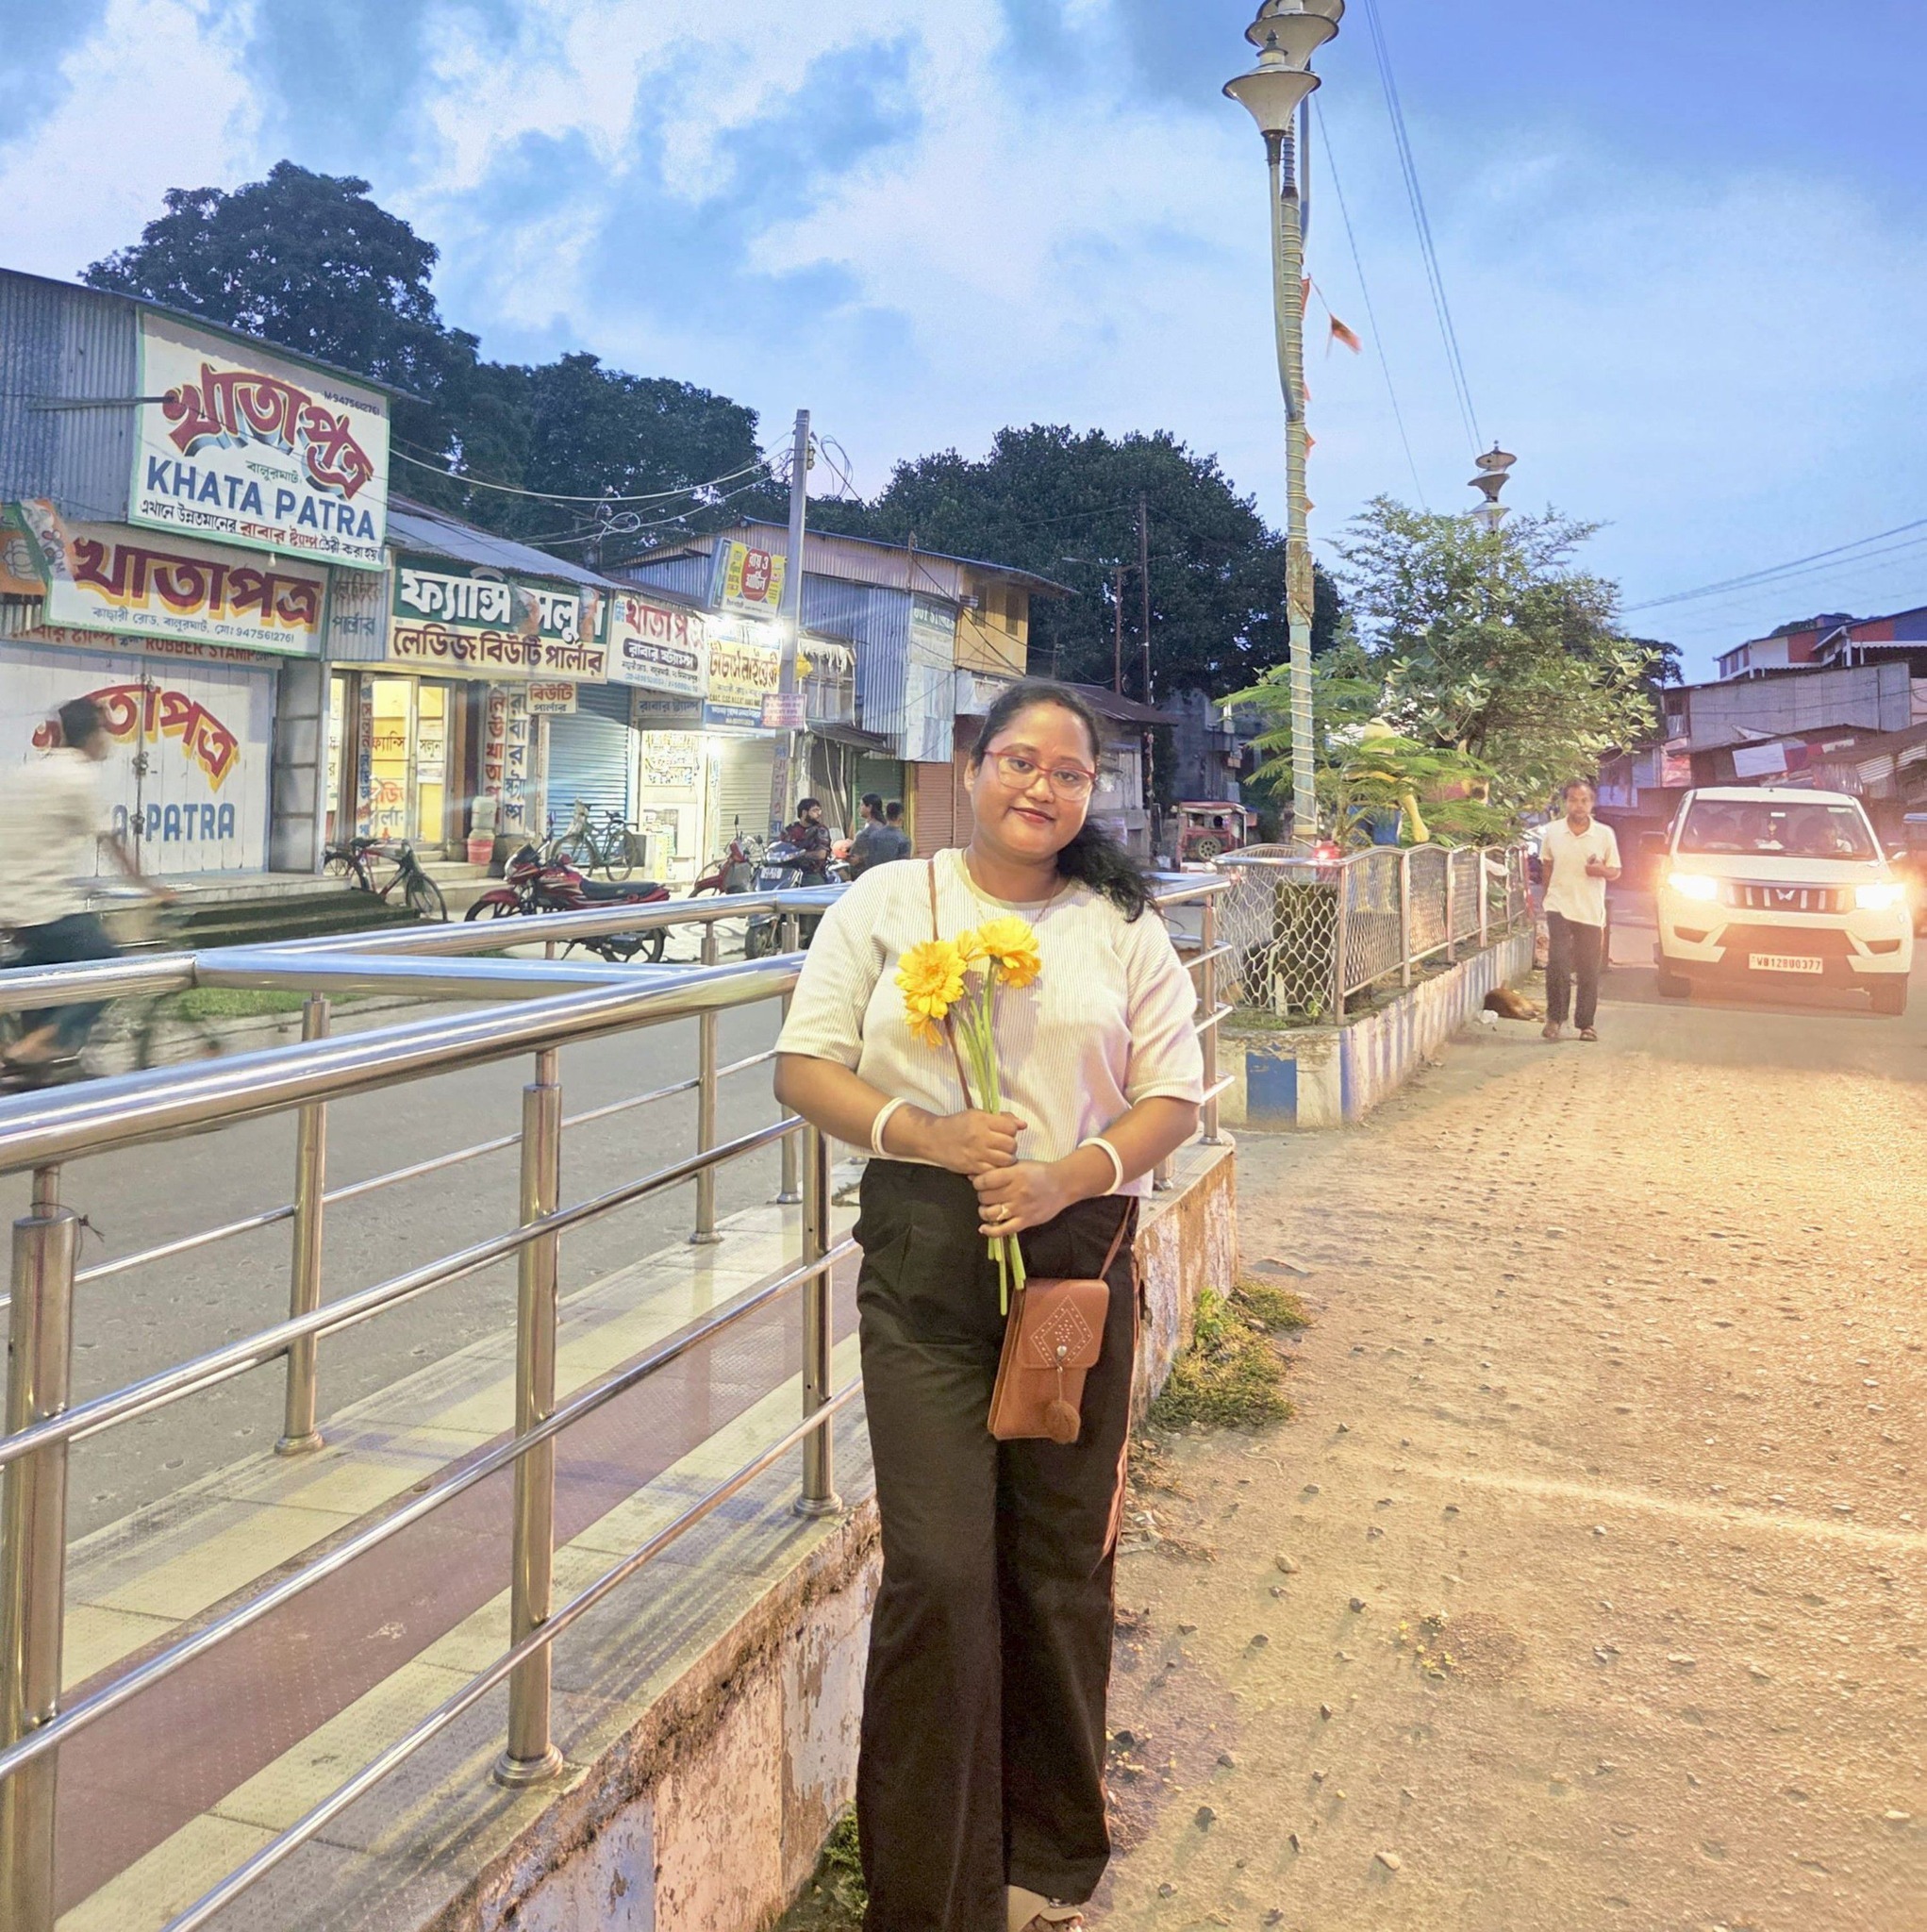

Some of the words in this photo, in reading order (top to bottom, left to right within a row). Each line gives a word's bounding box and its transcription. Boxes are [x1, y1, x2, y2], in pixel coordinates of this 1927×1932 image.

[162, 362, 374, 500] খাতাপত্র
[141, 500, 174, 520] এখানে
[240, 521, 287, 544] রাবার
[146, 456, 262, 515] KHATA
[274, 489, 375, 541] PATRA
[74, 536, 322, 625] খাতাপত্র
[401, 568, 511, 624] ফ্যান্সি
[145, 637, 203, 656] RUBBER
[236, 626, 294, 643] 9475612761
[393, 624, 476, 660] লেডিজ
[480, 630, 542, 666] বিউটি
[545, 641, 604, 675] পার্লার
[529, 682, 573, 701] বিউটি
[31, 683, 240, 792] তাপত্র
[146, 803, 235, 842] PATRA
